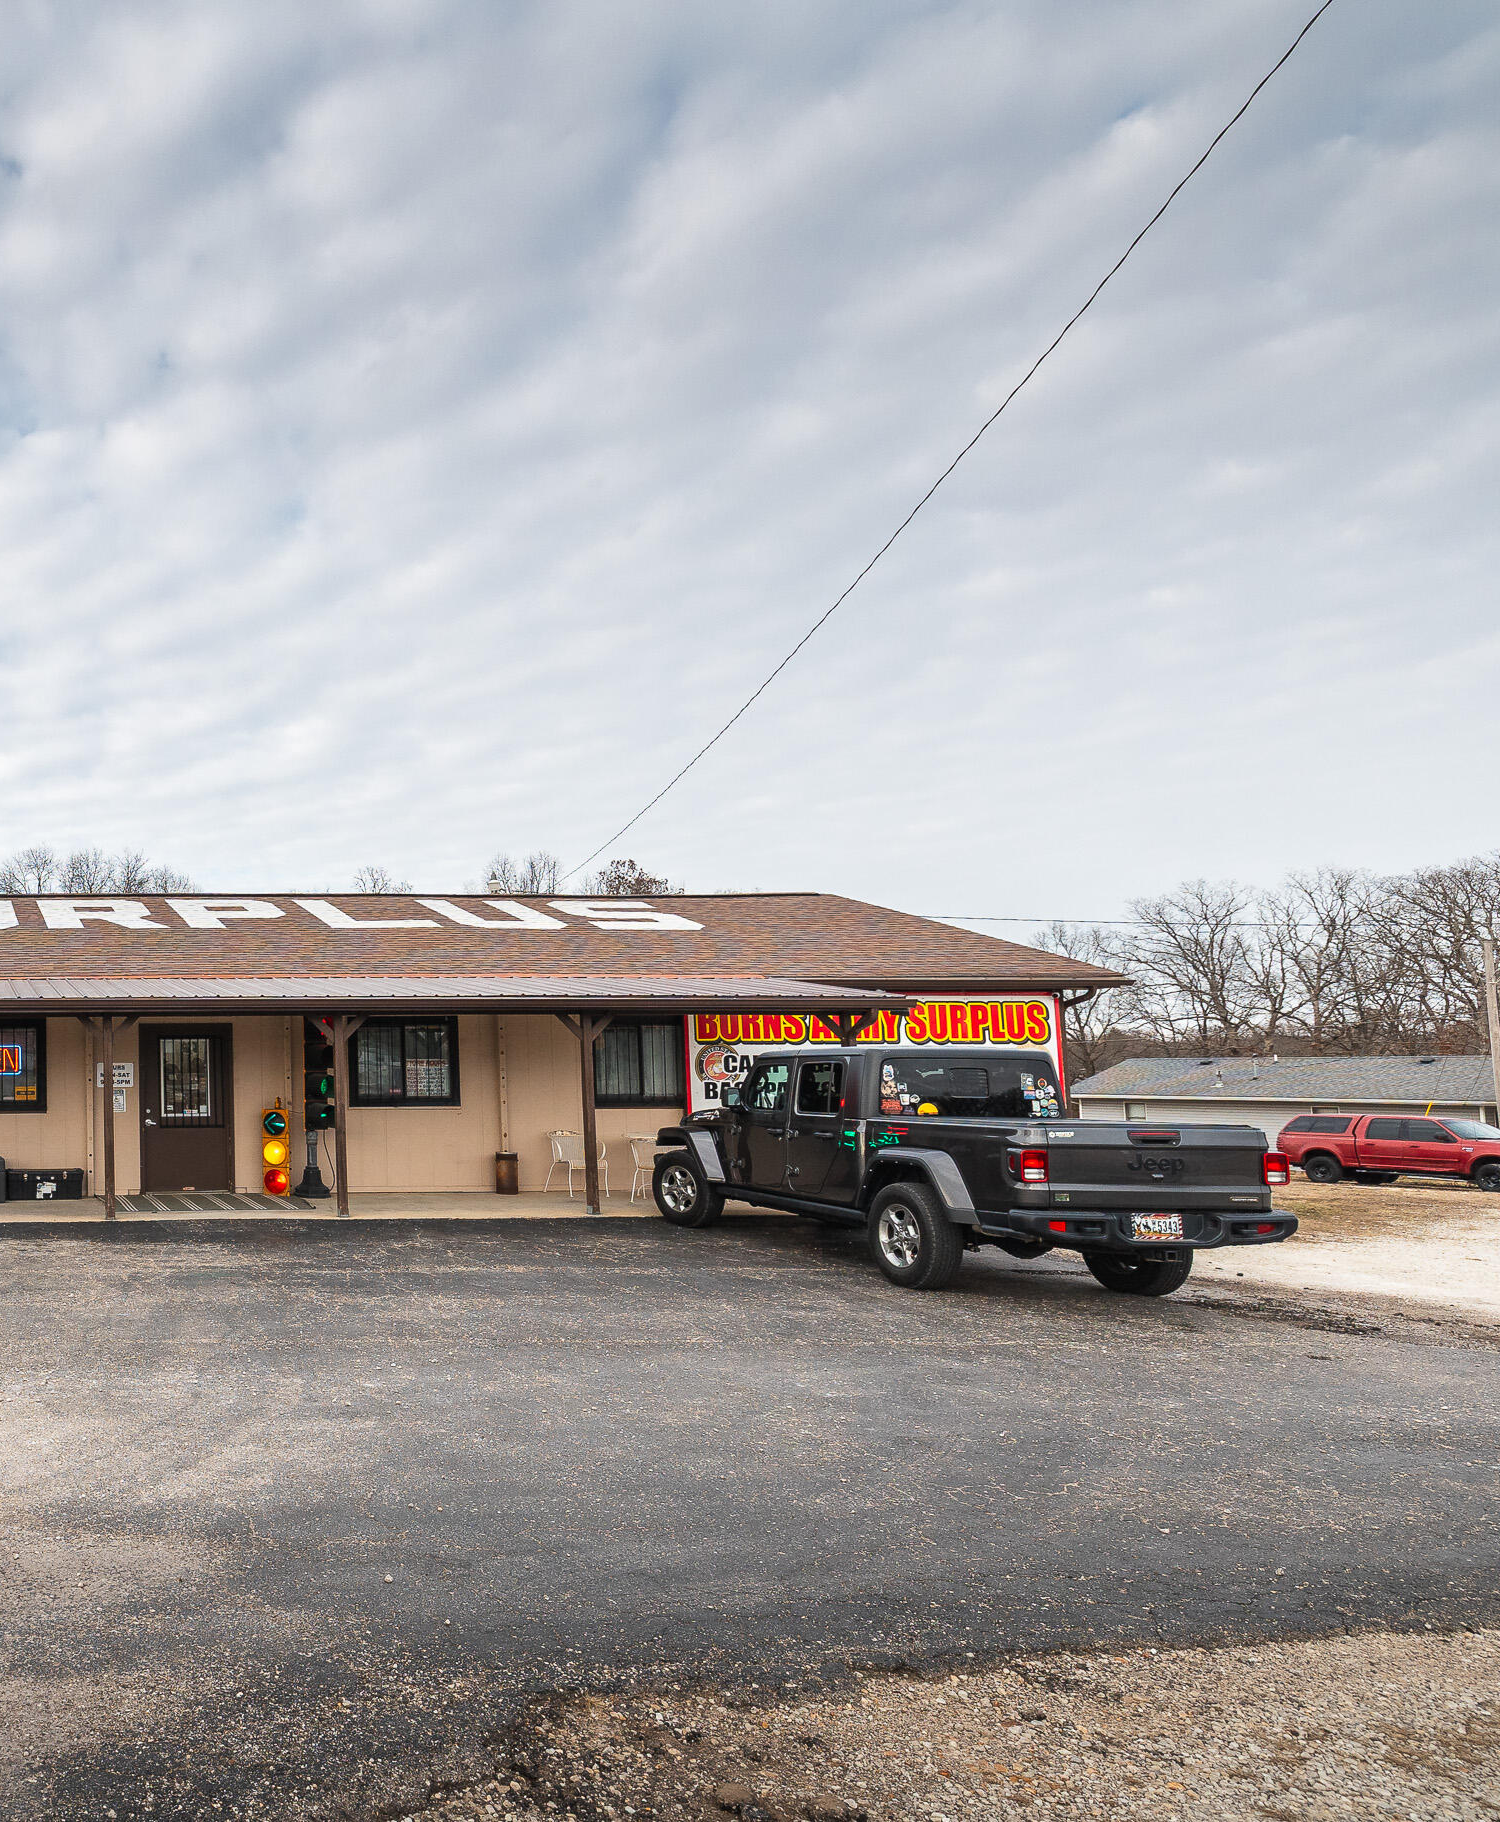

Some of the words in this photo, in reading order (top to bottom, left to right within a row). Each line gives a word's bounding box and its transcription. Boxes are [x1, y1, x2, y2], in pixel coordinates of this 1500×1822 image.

[695, 1014, 808, 1044] BURNS
[808, 1010, 900, 1044] AMY
[905, 1001, 1049, 1045] SURPLUS
[1127, 1153, 1185, 1176] Jeep
